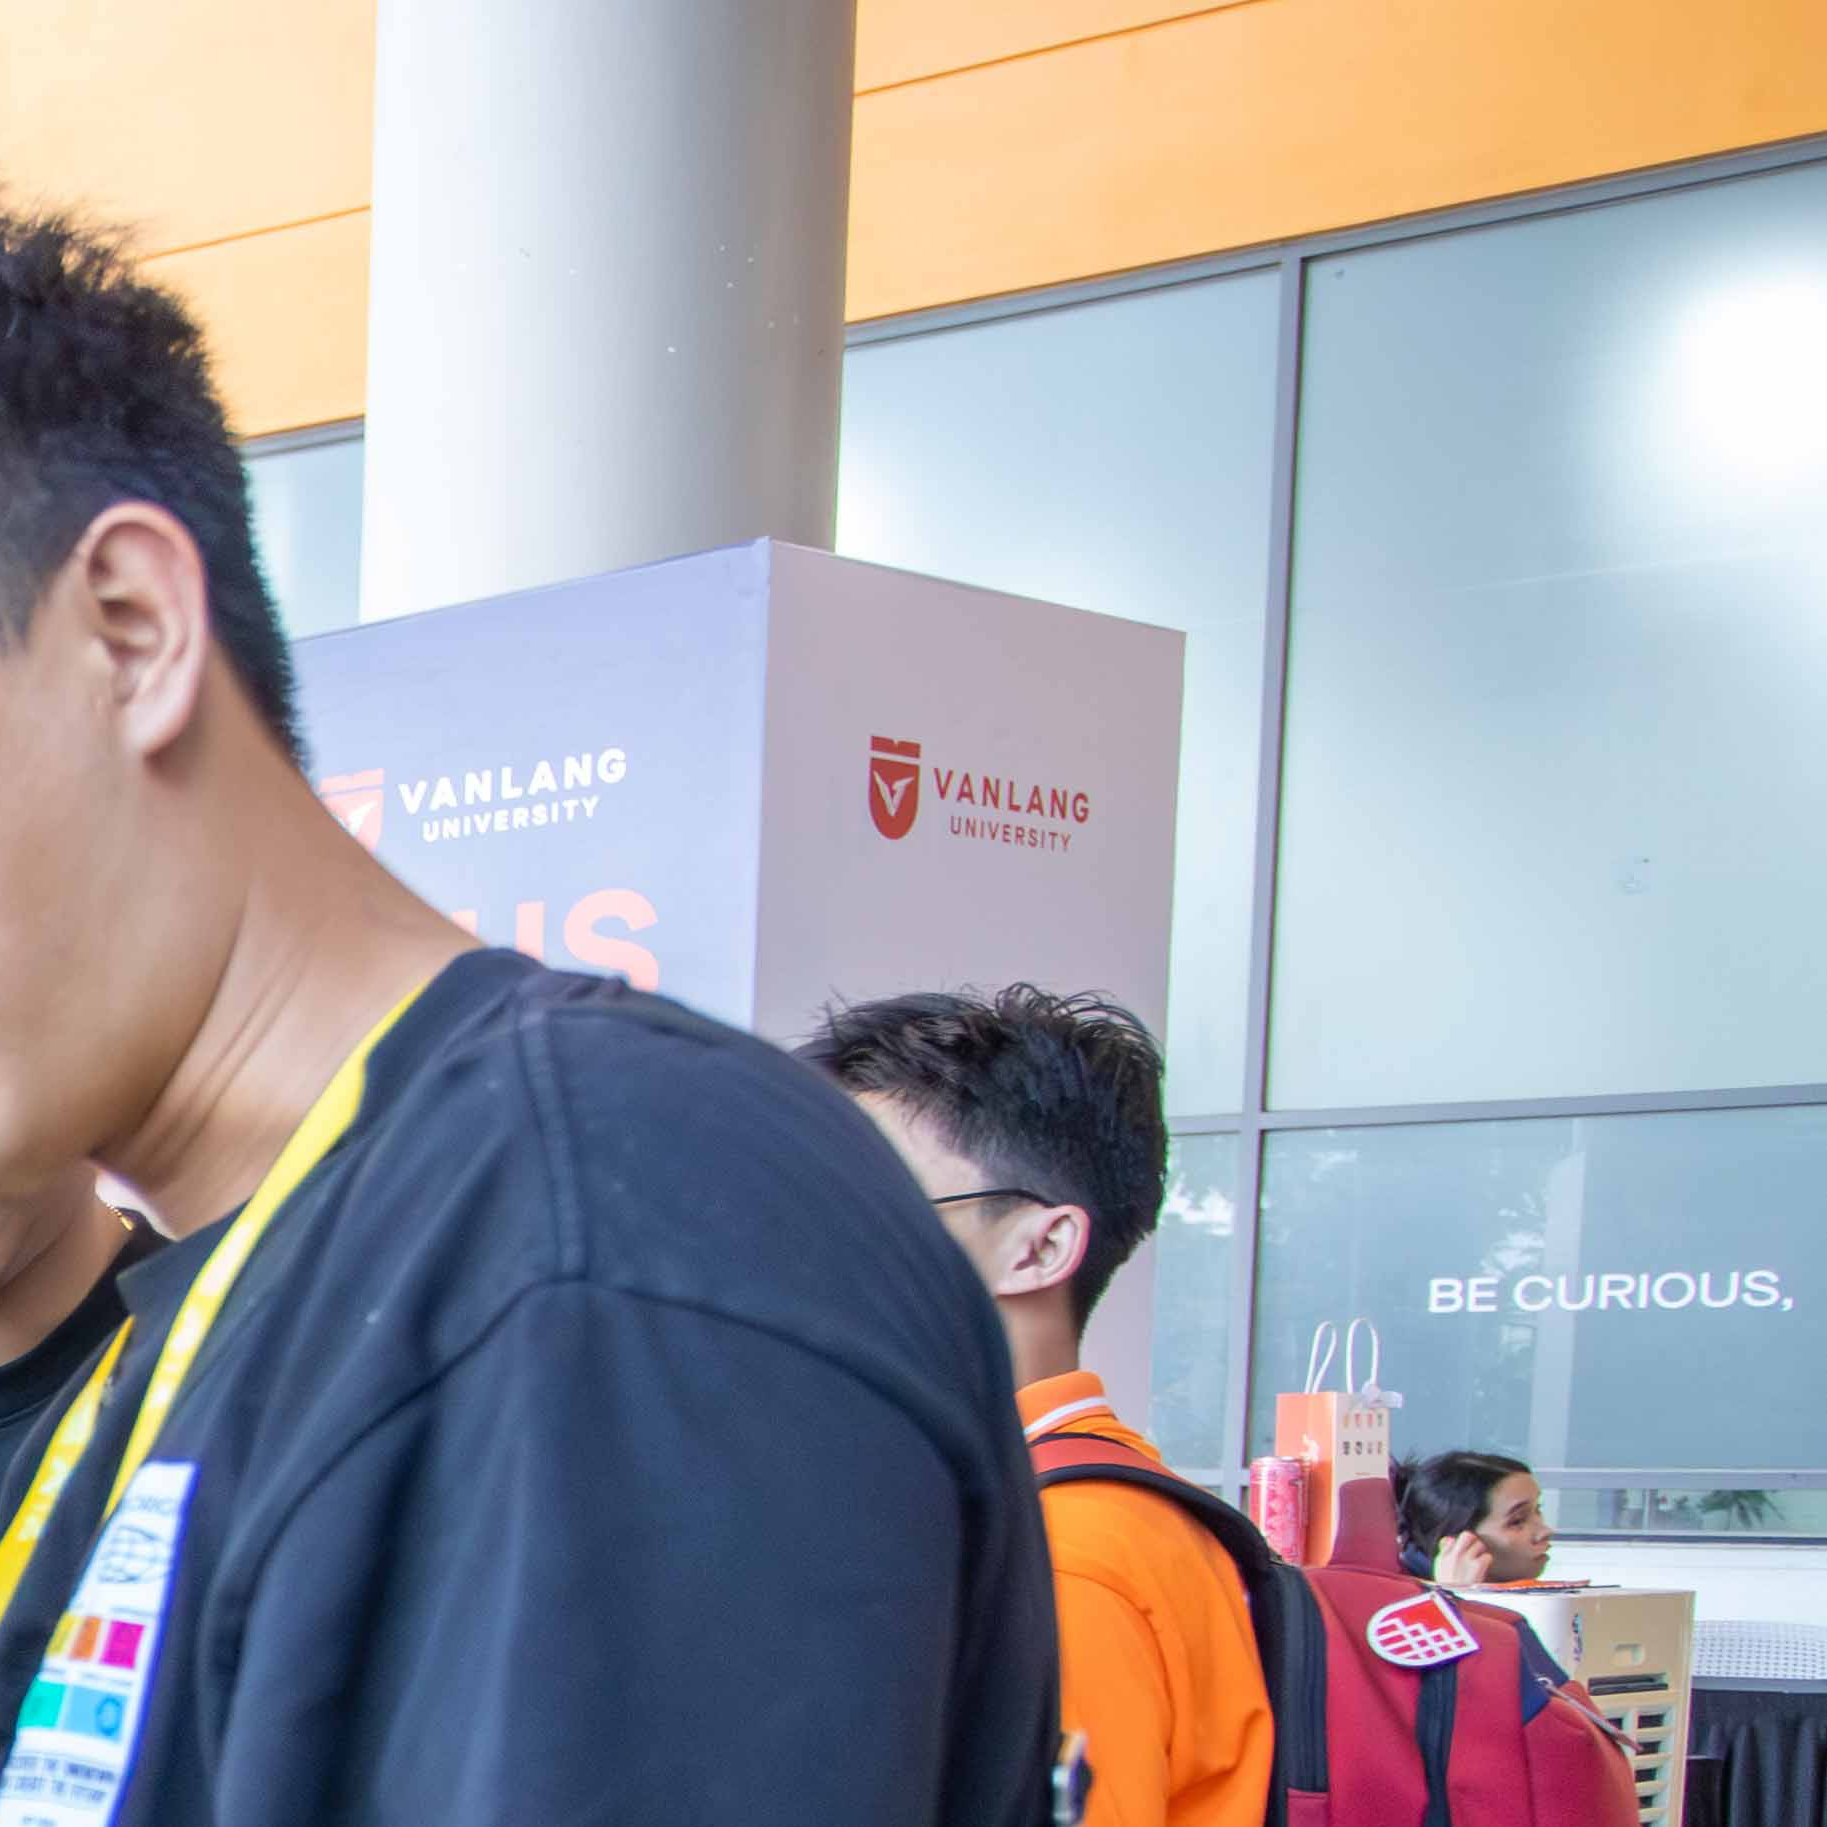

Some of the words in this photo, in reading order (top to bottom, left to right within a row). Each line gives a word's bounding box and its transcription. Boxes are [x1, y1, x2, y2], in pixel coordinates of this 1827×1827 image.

[398, 748, 626, 815] VANLANG
[933, 767, 1090, 824] VANLANG
[422, 795, 600, 842] UNIVERSITY
[950, 815, 1071, 852] UNIVERSITY
[1427, 1276, 1500, 1314] BE
[1513, 1269, 1796, 1313] CURIOUS,
